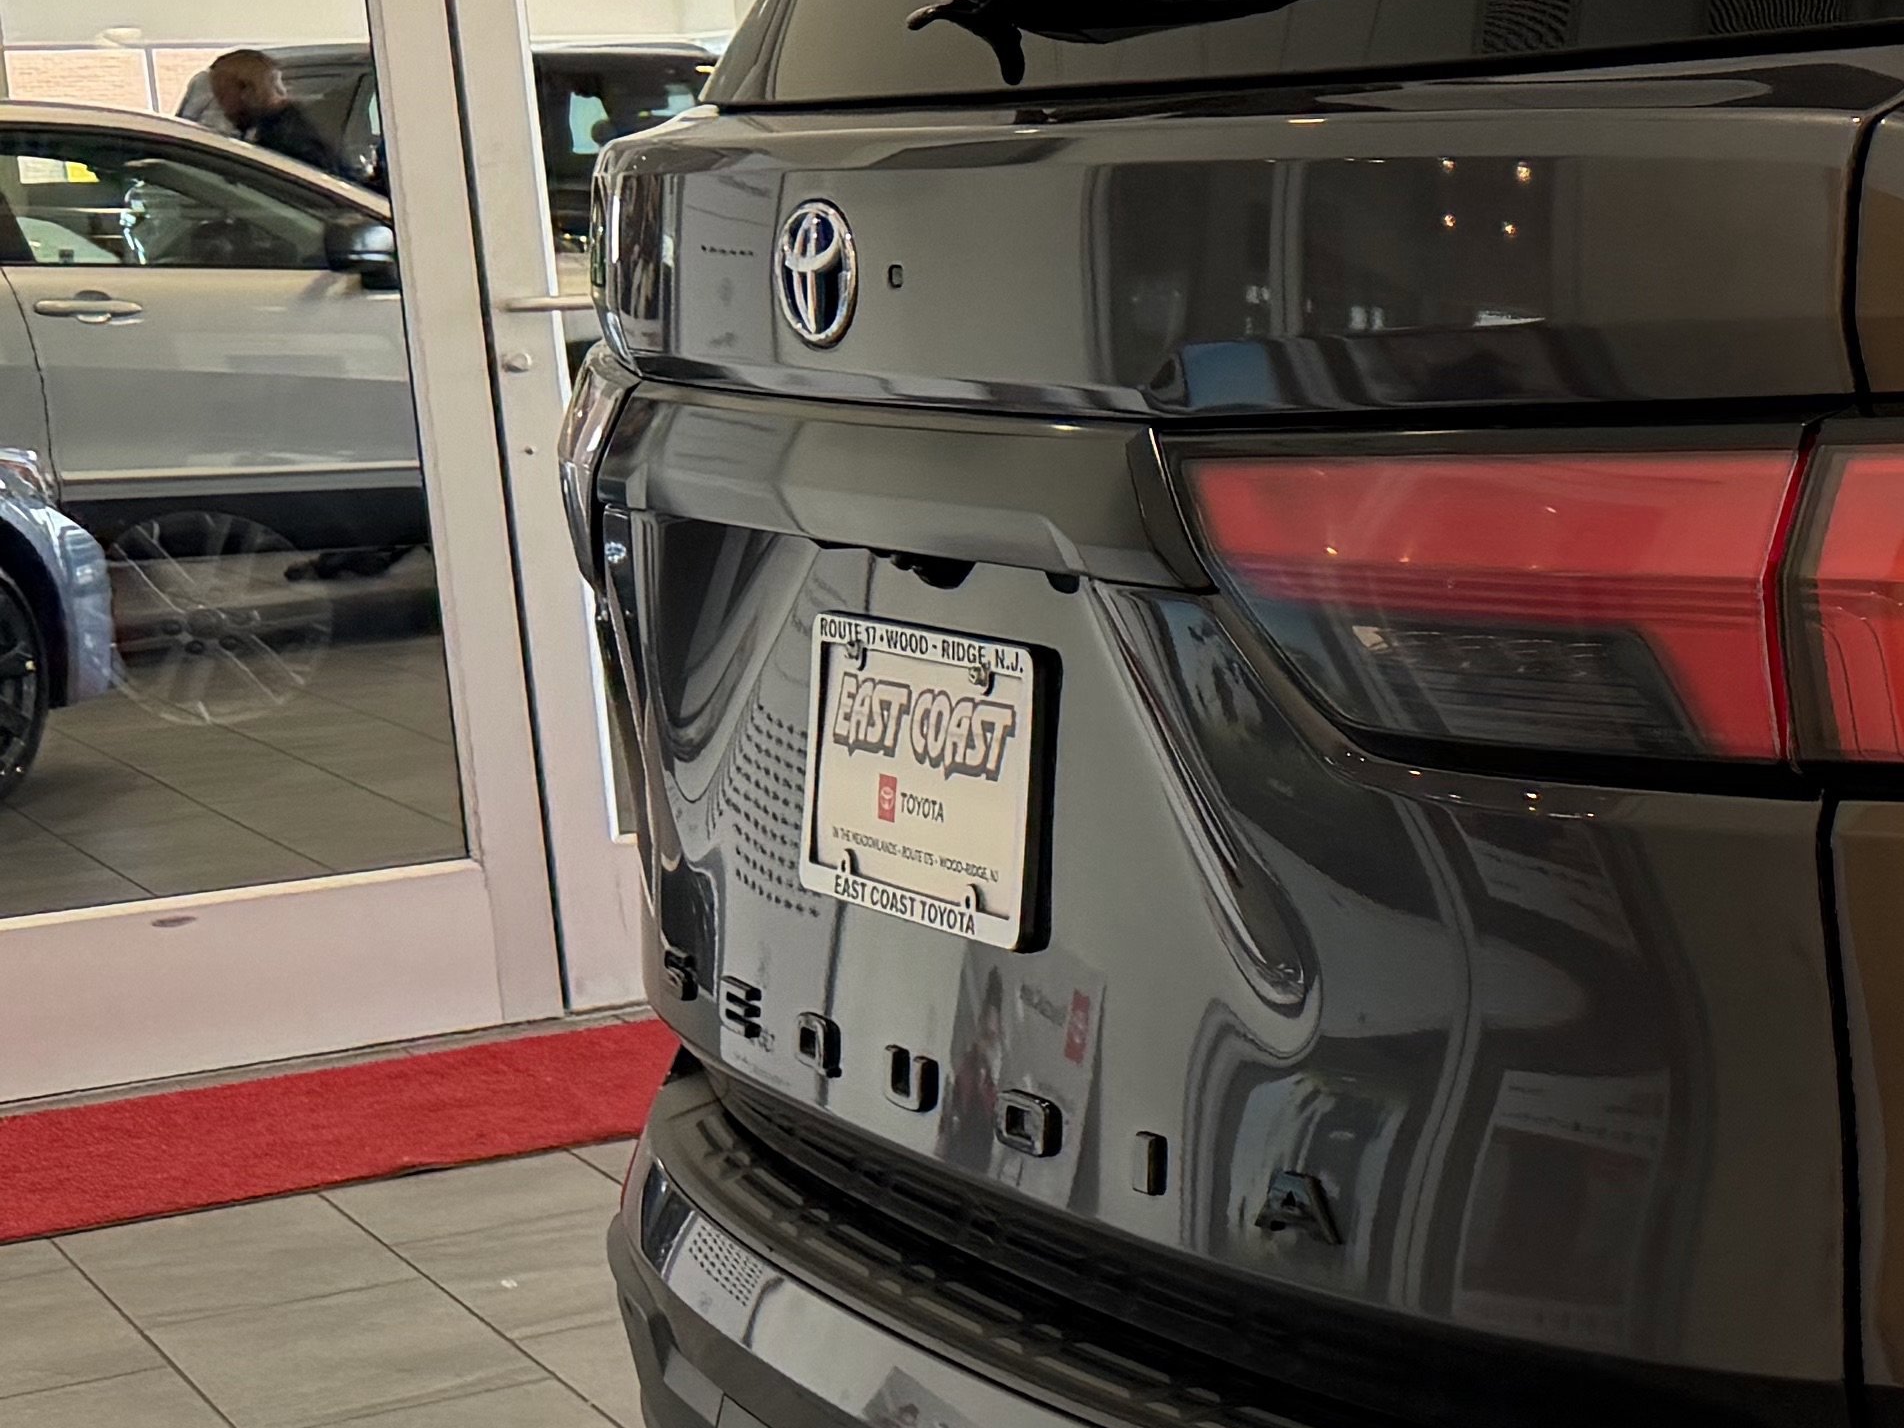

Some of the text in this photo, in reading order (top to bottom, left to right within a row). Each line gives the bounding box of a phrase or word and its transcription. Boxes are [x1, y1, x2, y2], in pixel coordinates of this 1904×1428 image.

[819, 617, 863, 645] ROUTE
[885, 629, 929, 655] WOOD
[995, 647, 1024, 673] N.J.
[833, 671, 1018, 781] EAST COAST
[900, 791, 946, 824] TOYOTA
[834, 874, 977, 936] EAST COAST TOYOTA
